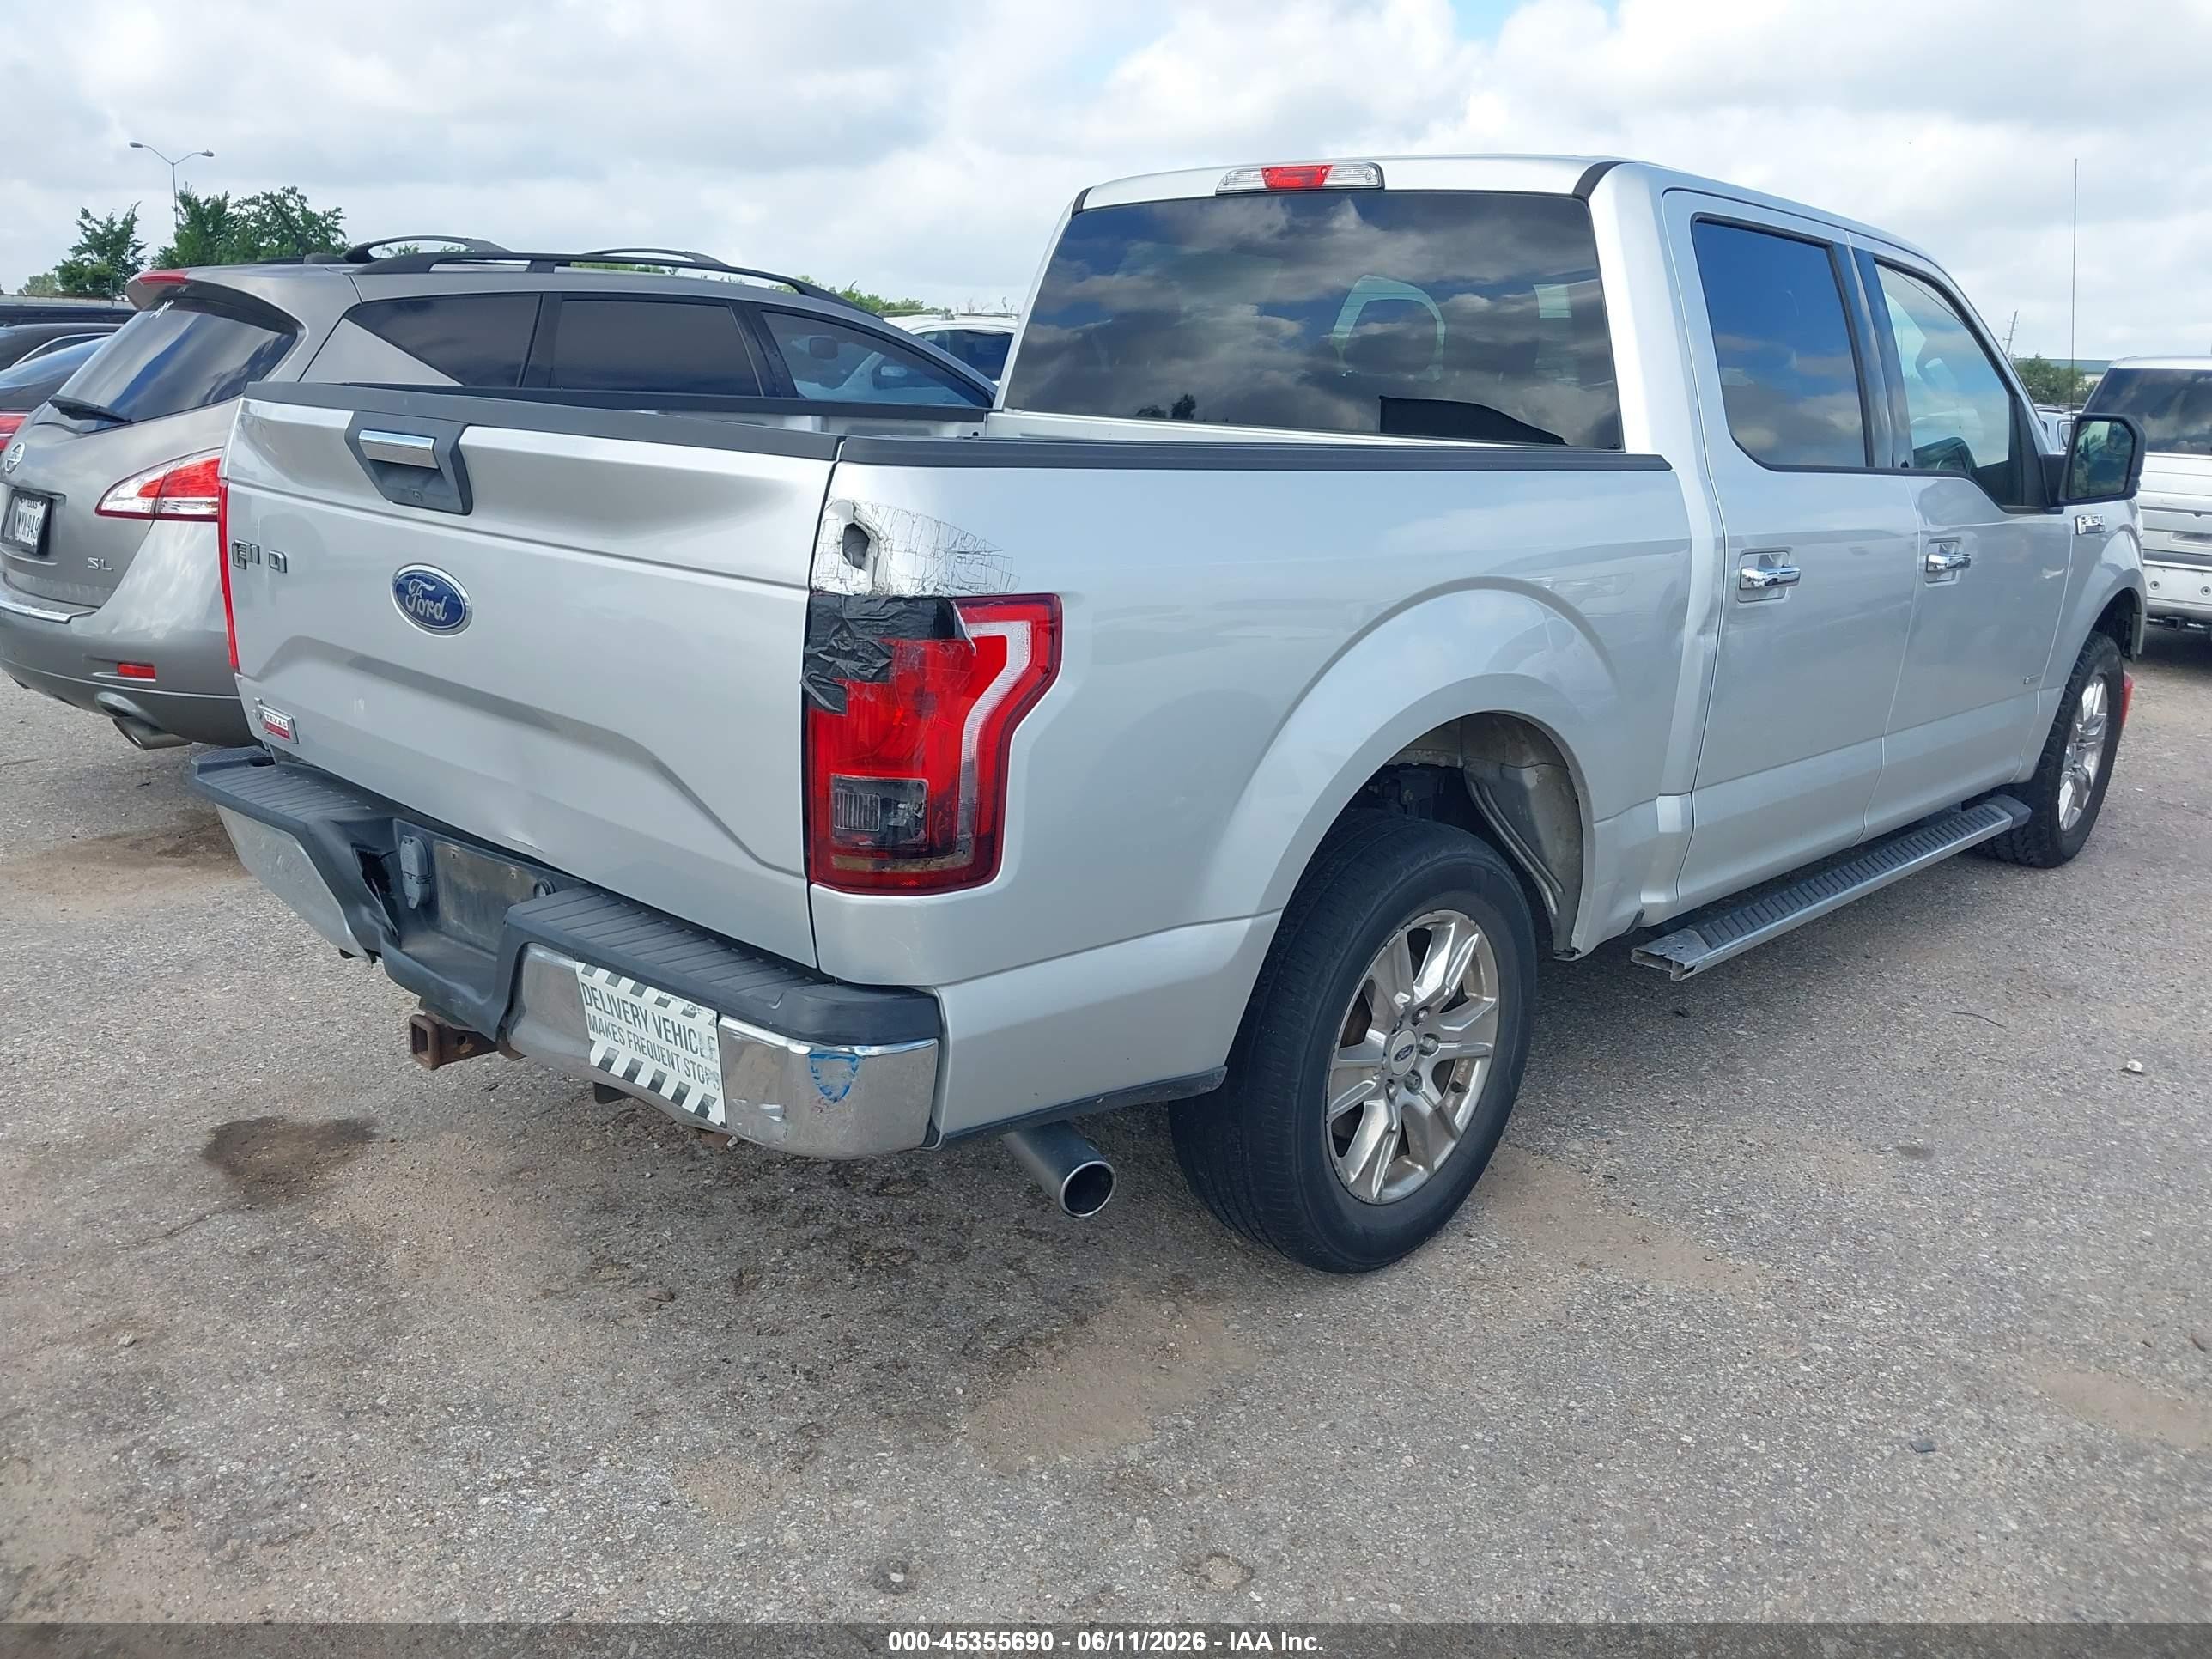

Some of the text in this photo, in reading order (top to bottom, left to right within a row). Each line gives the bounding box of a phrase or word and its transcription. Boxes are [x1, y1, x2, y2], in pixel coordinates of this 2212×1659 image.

[87, 556, 113, 571] SL
[405, 578, 447, 622] Ford
[266, 714, 288, 729] TEXAS
[580, 981, 649, 1034] DELIVERY
[587, 1012, 626, 1046] MAKES
[626, 1030, 681, 1073] FREQUENT
